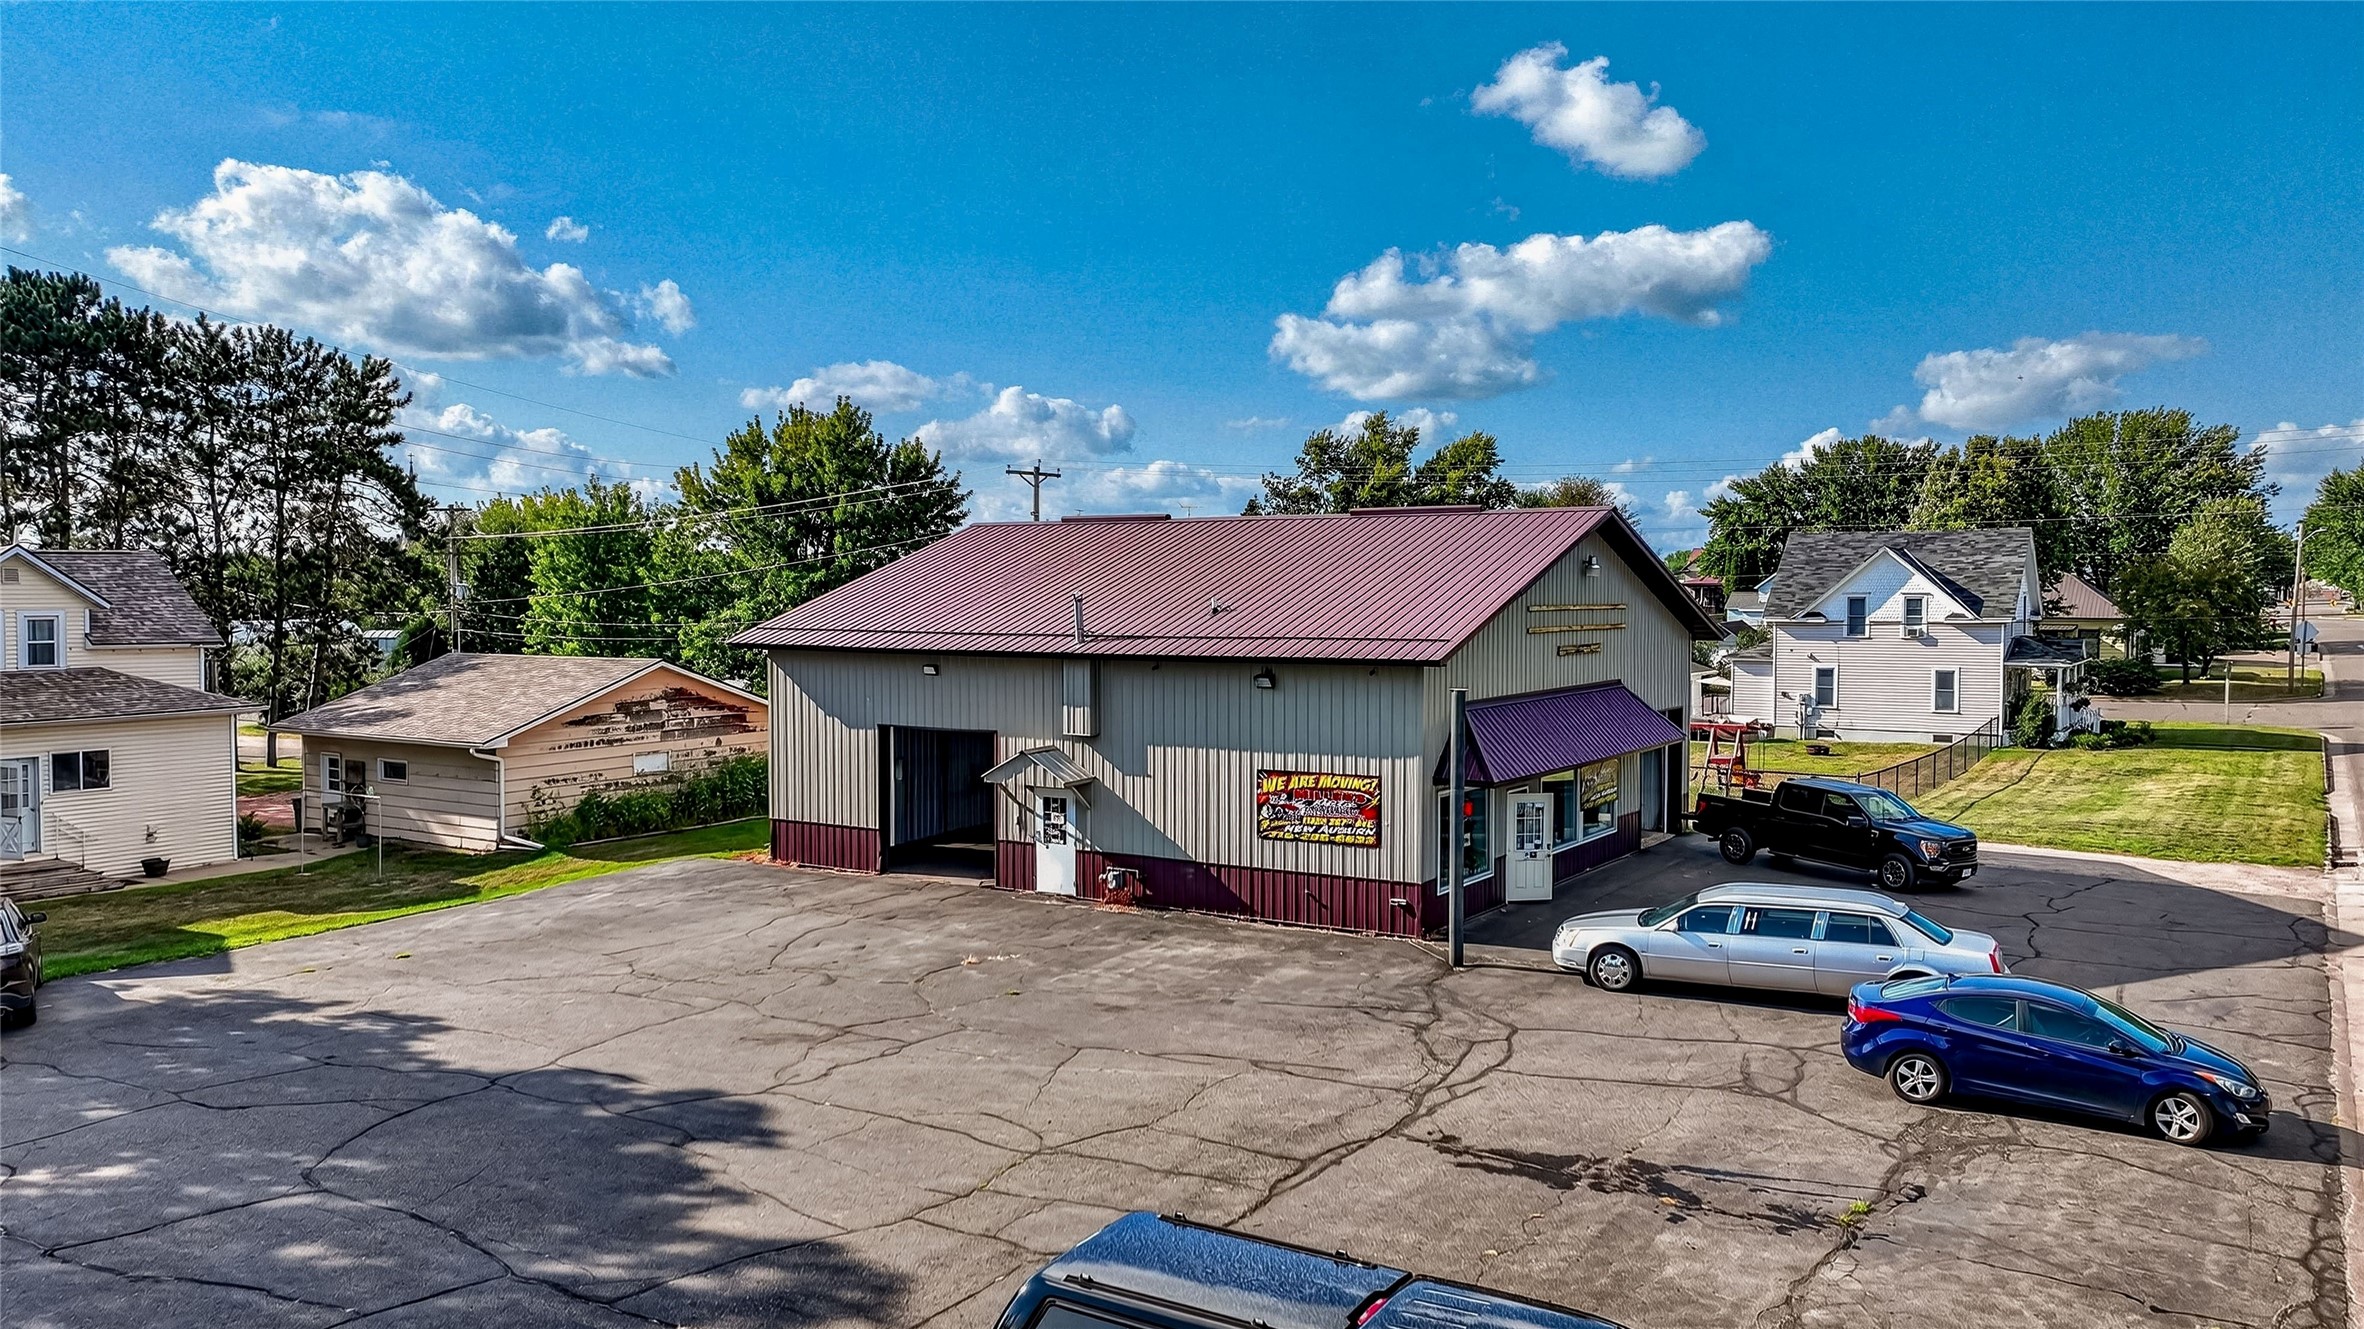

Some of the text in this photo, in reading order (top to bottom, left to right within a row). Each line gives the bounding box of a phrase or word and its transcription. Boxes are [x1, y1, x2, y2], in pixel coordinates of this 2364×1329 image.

[1262, 776, 1287, 793] WE
[1288, 775, 1316, 790] ARE
[1285, 824, 1376, 836] NEW AUBURN
